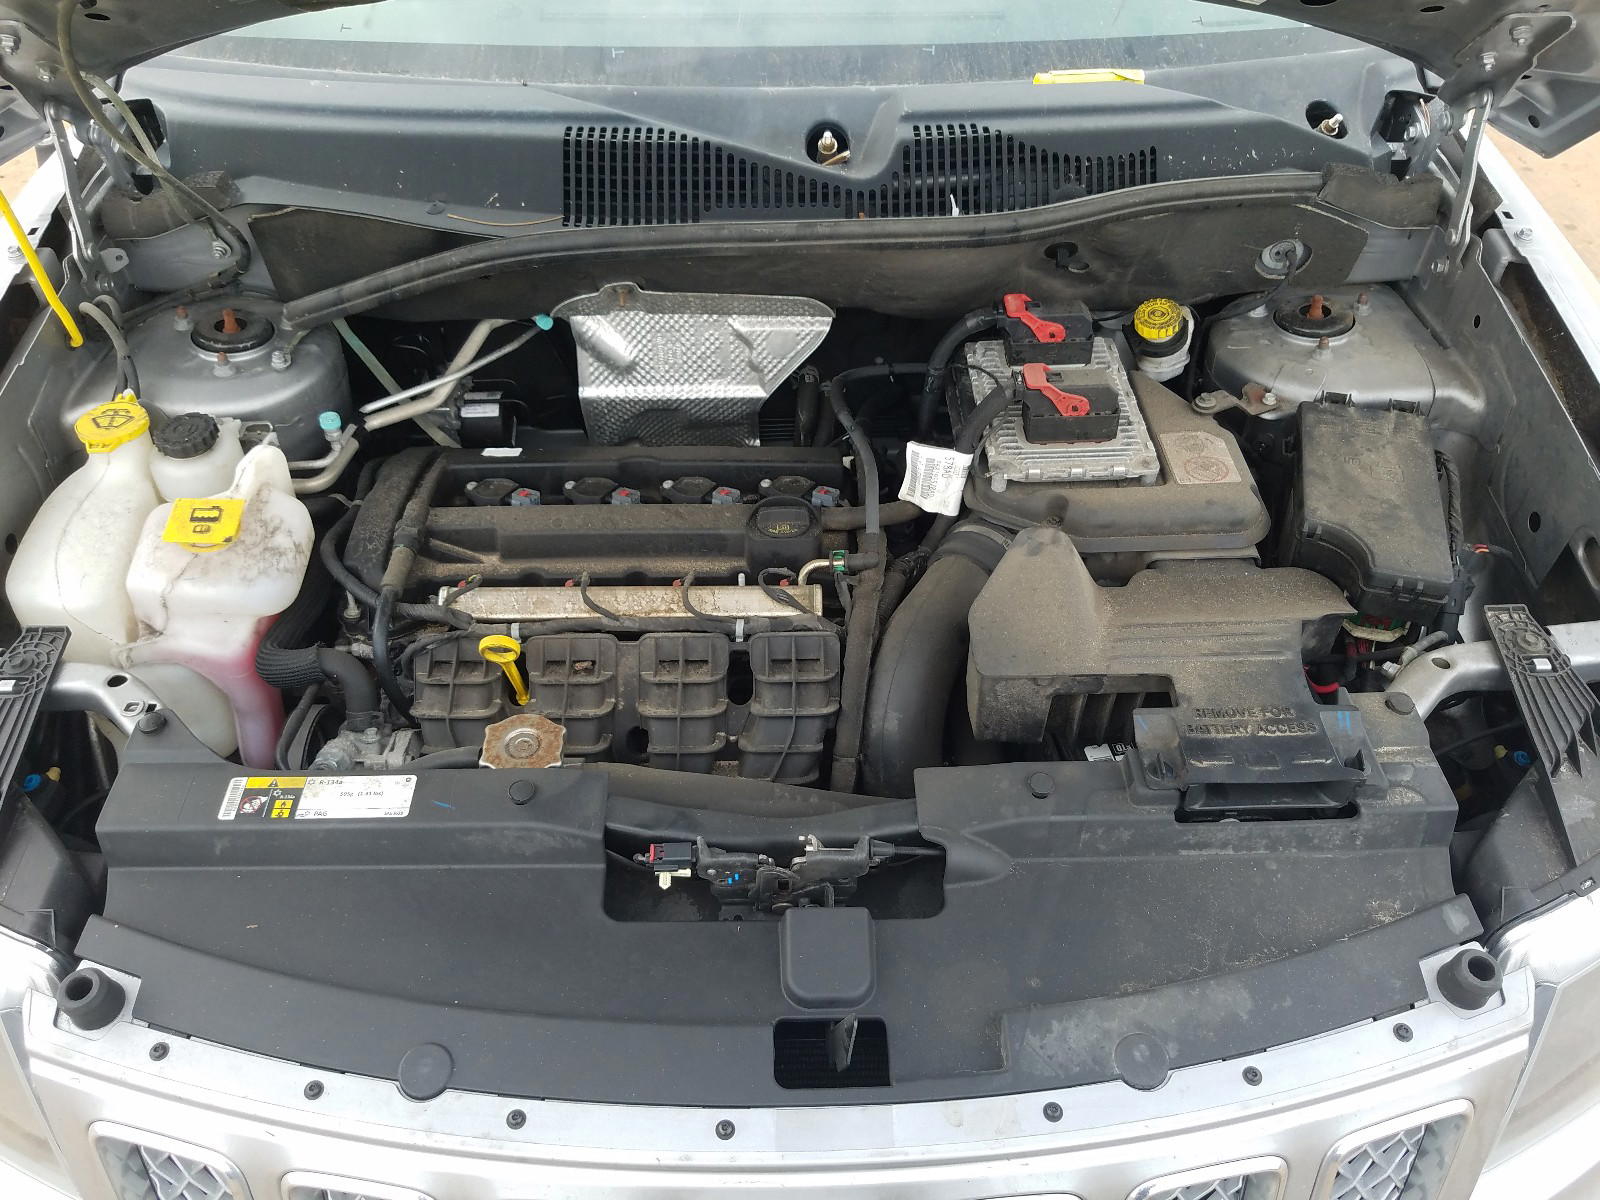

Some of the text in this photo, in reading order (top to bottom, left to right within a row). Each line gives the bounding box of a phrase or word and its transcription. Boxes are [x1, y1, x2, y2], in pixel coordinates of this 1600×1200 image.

[1194, 706, 1296, 719] REMOVE FOR
[1185, 721, 1319, 736] BATTERY ACCESS
